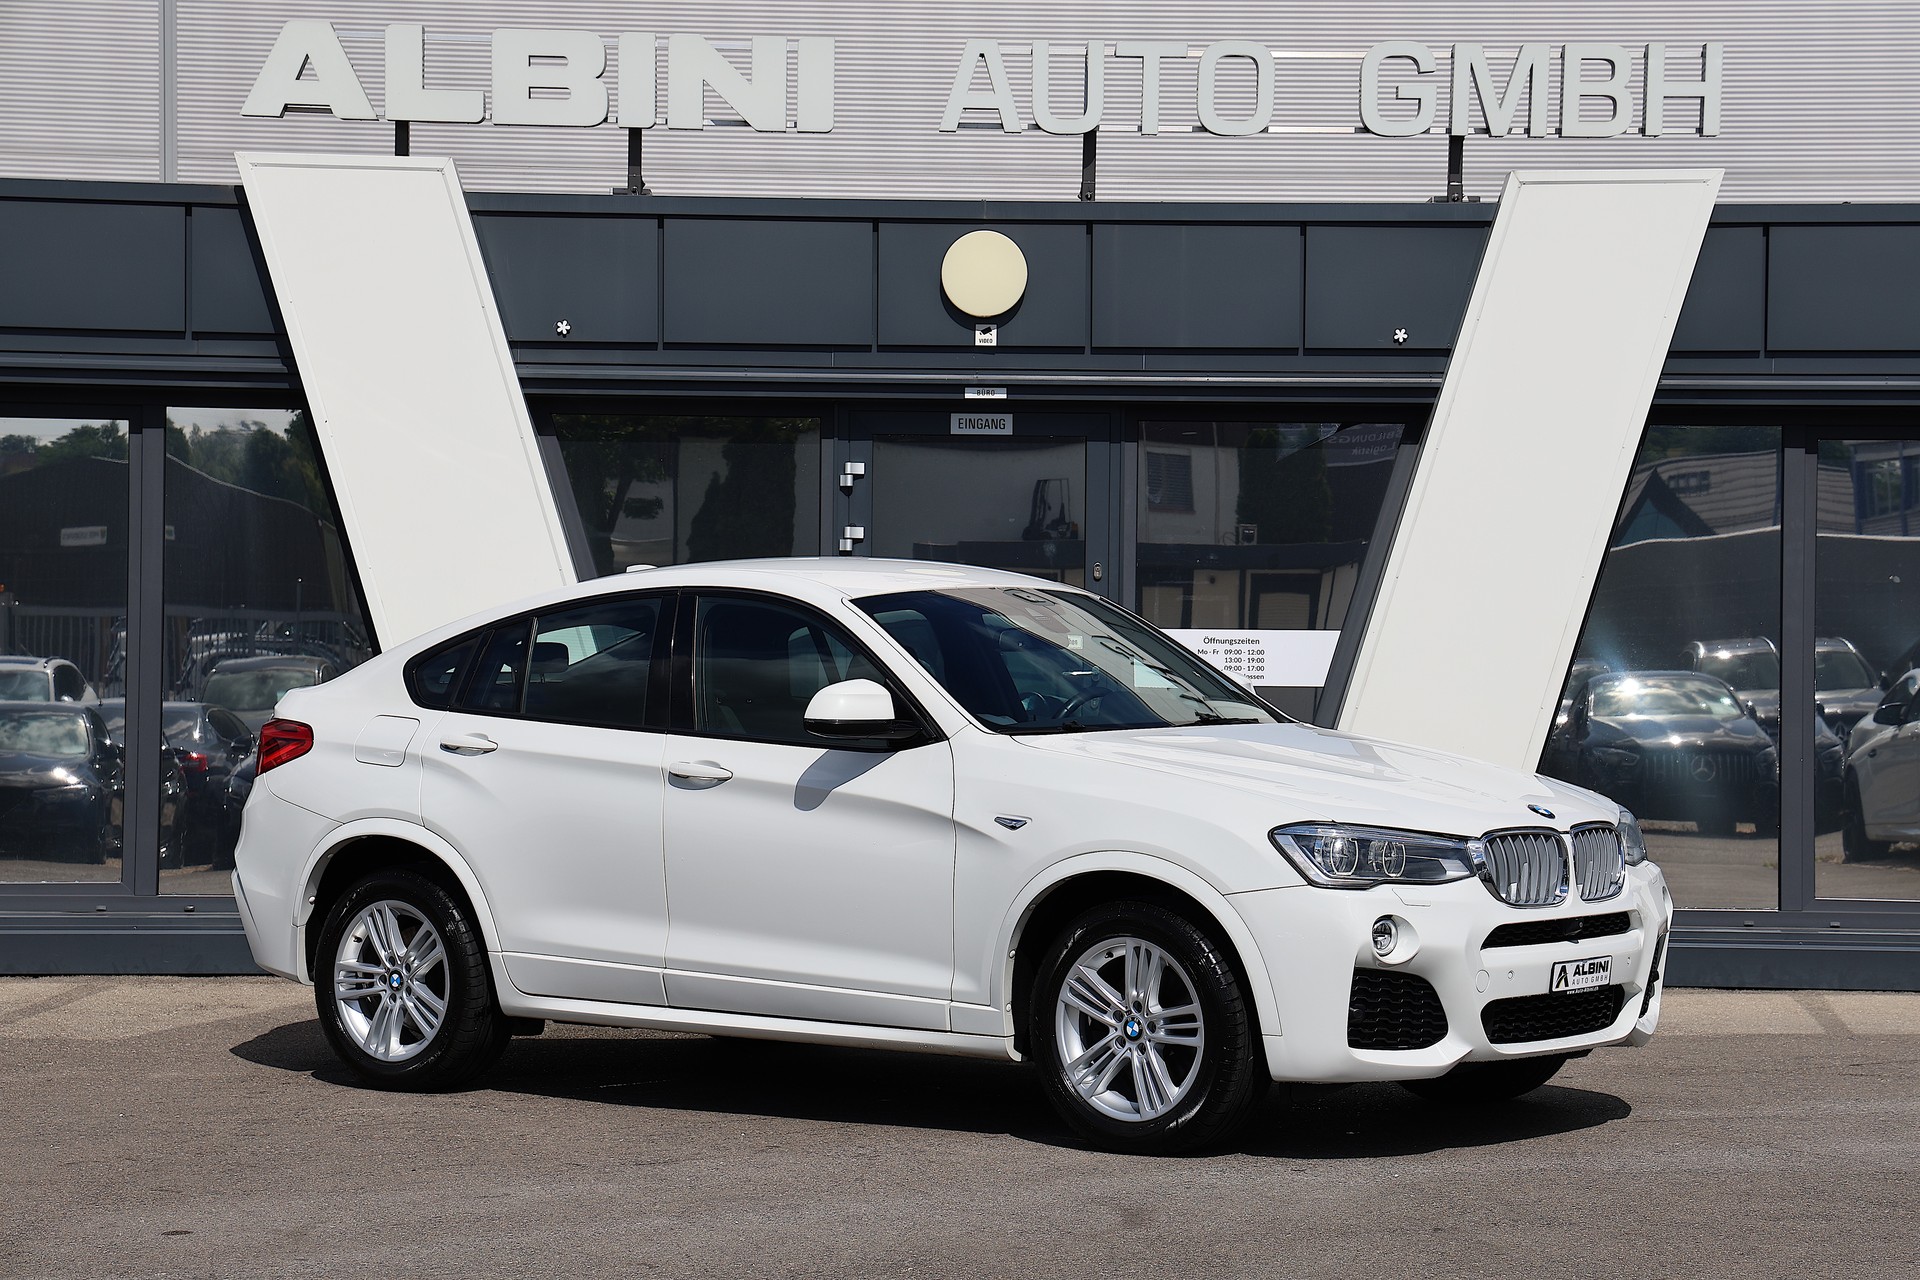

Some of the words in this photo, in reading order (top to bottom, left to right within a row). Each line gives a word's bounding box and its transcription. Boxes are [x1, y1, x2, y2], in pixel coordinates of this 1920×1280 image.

[240, 20, 835, 133] ALBINI
[939, 38, 1276, 137] AUTO
[1358, 40, 1724, 139] GMBH
[976, 388, 996, 396] BÜRO
[958, 418, 1006, 430] EINGANG
[1203, 636, 1260, 646] Öffnungszeiten
[1573, 960, 1609, 977] ALBINI
[1572, 977, 1588, 986] AUTO
